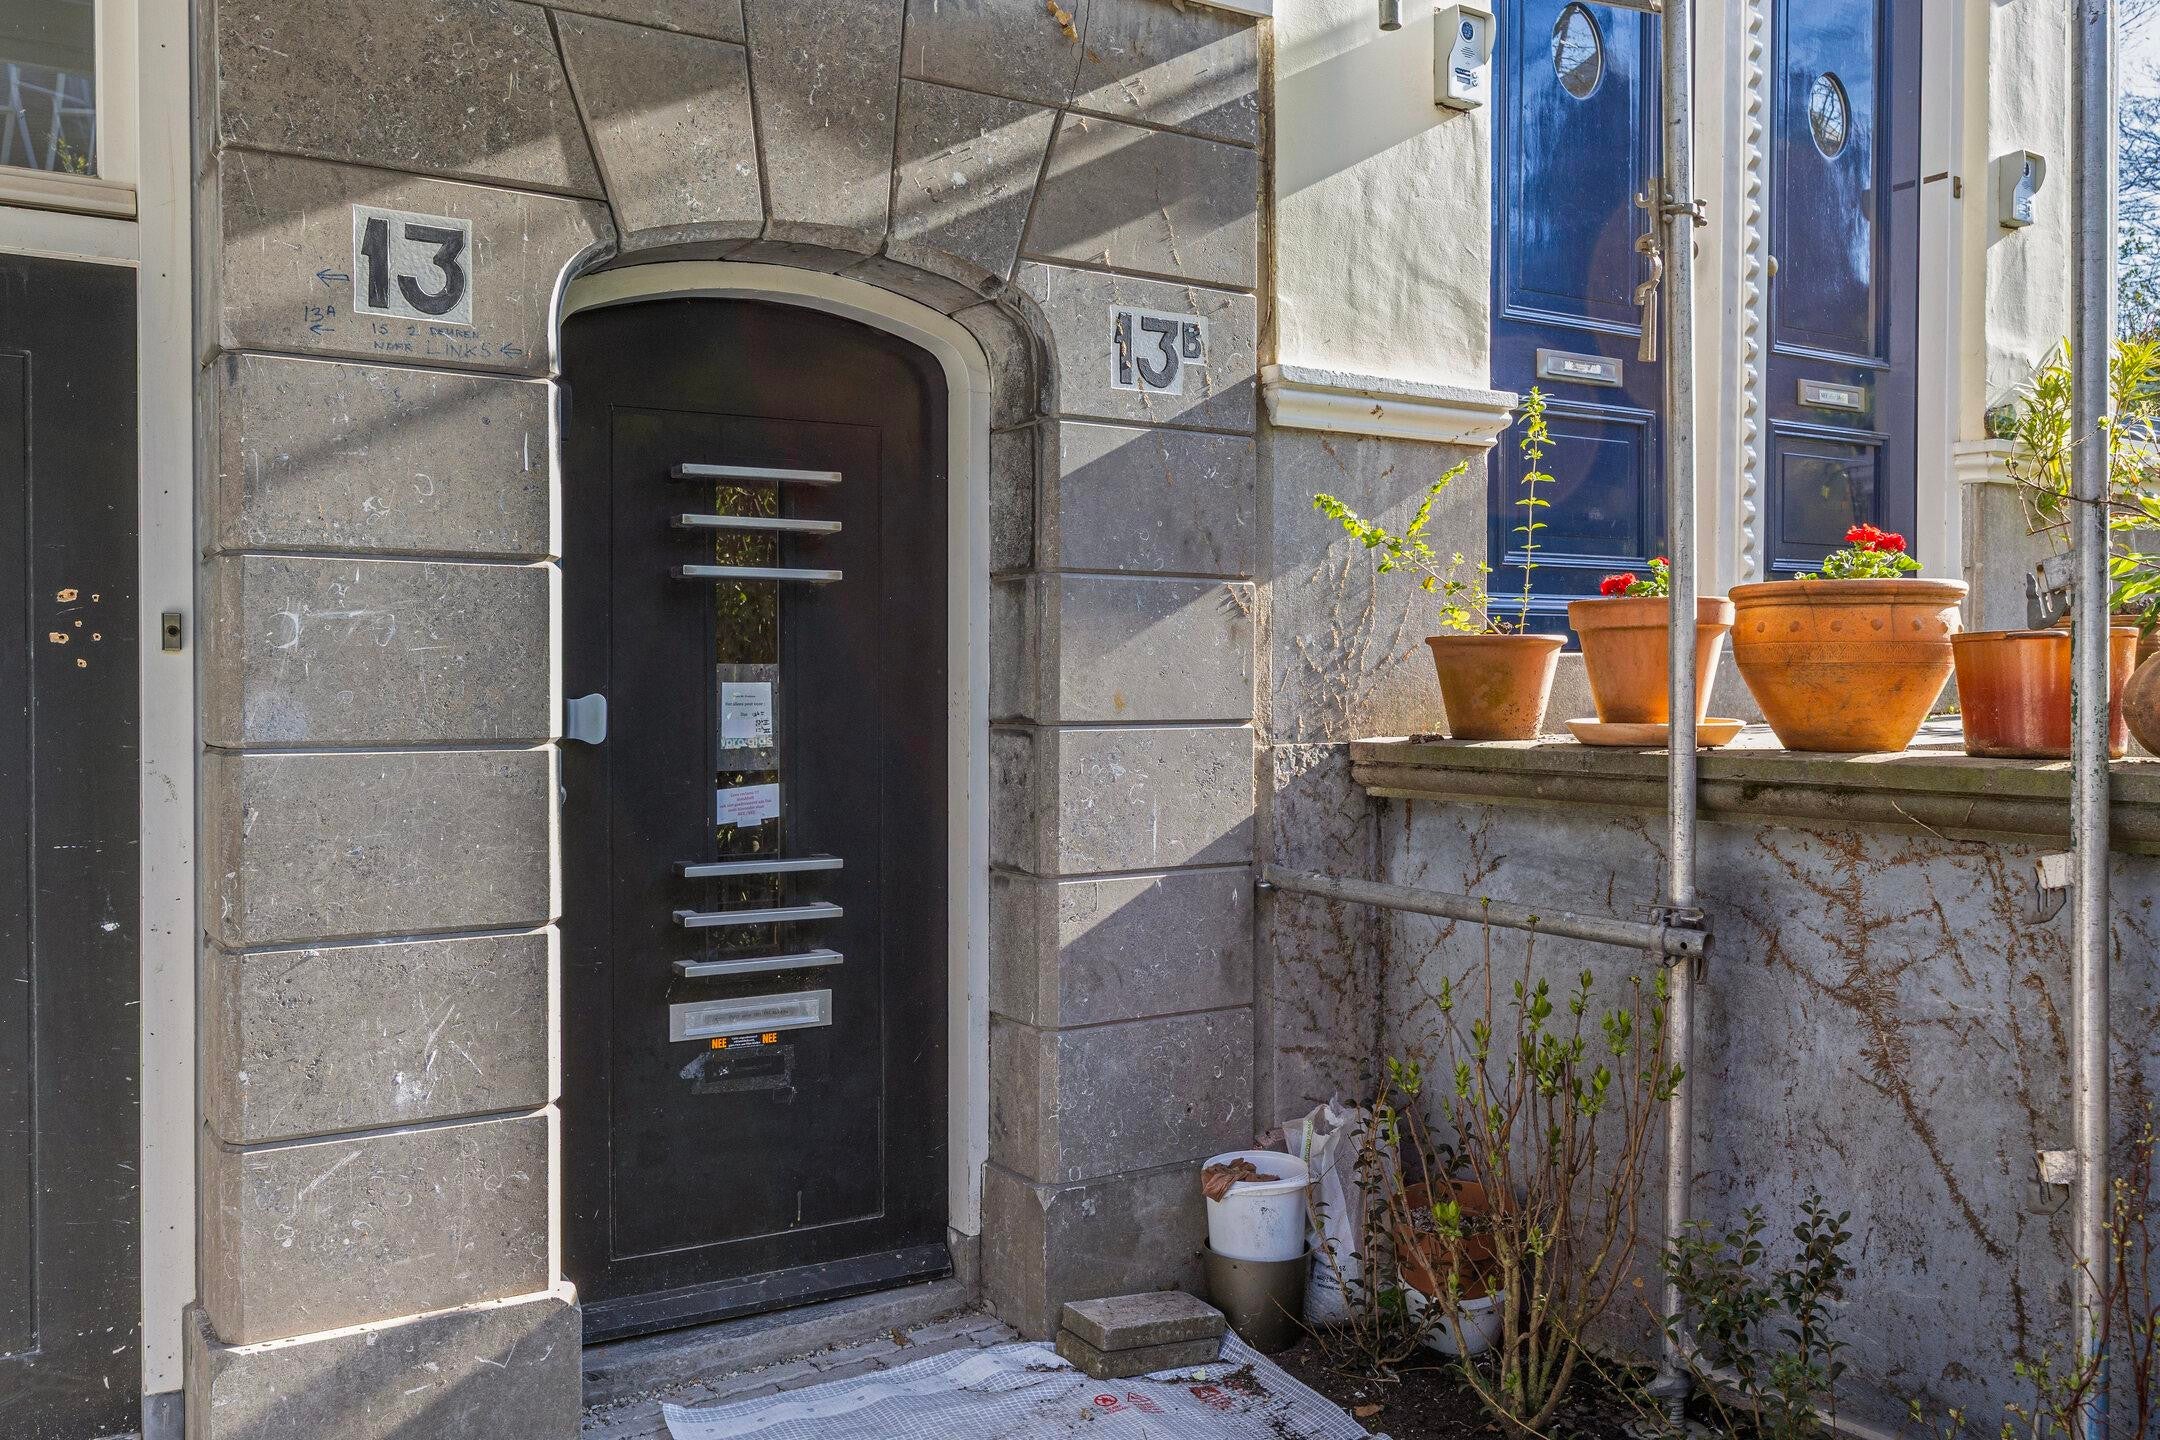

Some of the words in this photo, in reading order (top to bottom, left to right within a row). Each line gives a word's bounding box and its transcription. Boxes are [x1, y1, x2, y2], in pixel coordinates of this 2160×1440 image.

[361, 217, 466, 315] 13
[304, 304, 336, 322] 13A
[426, 340, 492, 357] LINKS
[711, 1038, 727, 1049] NEE
[762, 1032, 778, 1044] NEE
